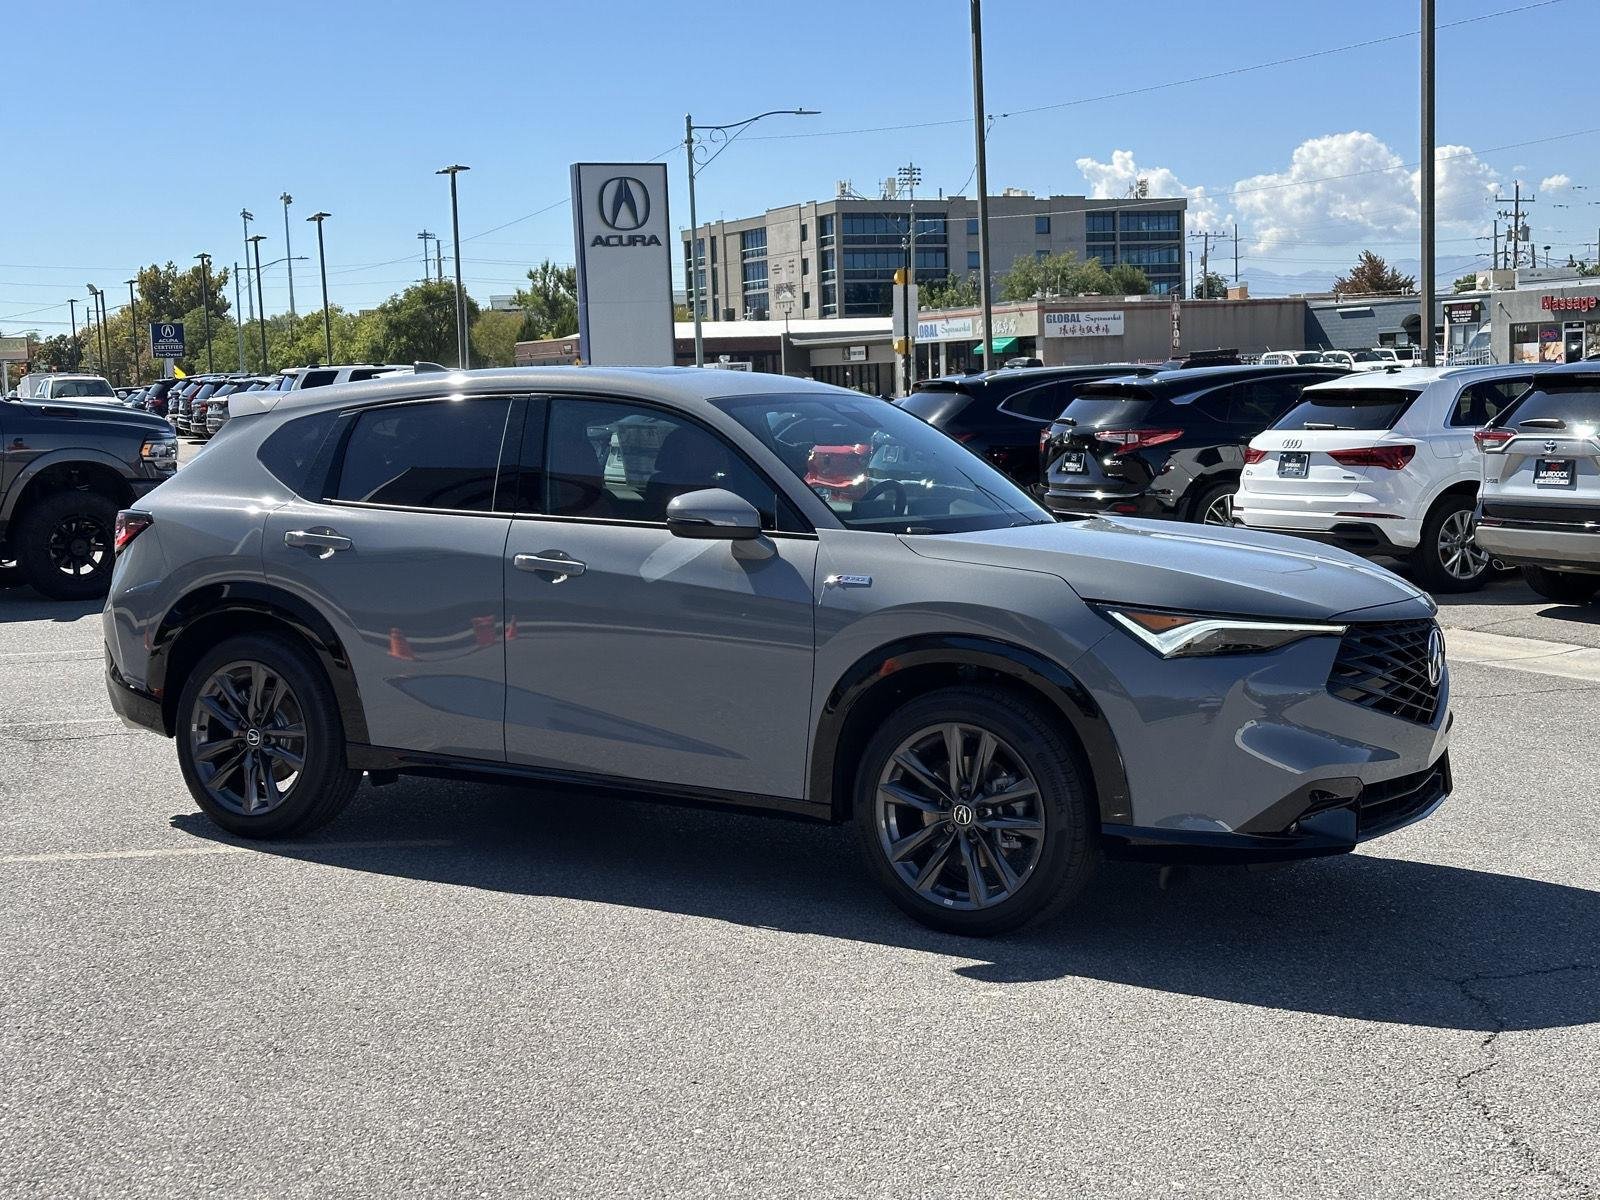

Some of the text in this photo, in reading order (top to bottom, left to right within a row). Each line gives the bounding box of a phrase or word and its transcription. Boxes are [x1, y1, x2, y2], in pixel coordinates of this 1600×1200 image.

[591, 234, 662, 247] ACURA
[1541, 295, 1597, 312] Massage
[1046, 313, 1122, 324] GLOBAL Supermarket
[1172, 294, 1180, 349] TATTOO
[918, 324, 939, 337] OBAL
[1514, 325, 1527, 333] 1144
[1539, 470, 1568, 478] MURDOCK
